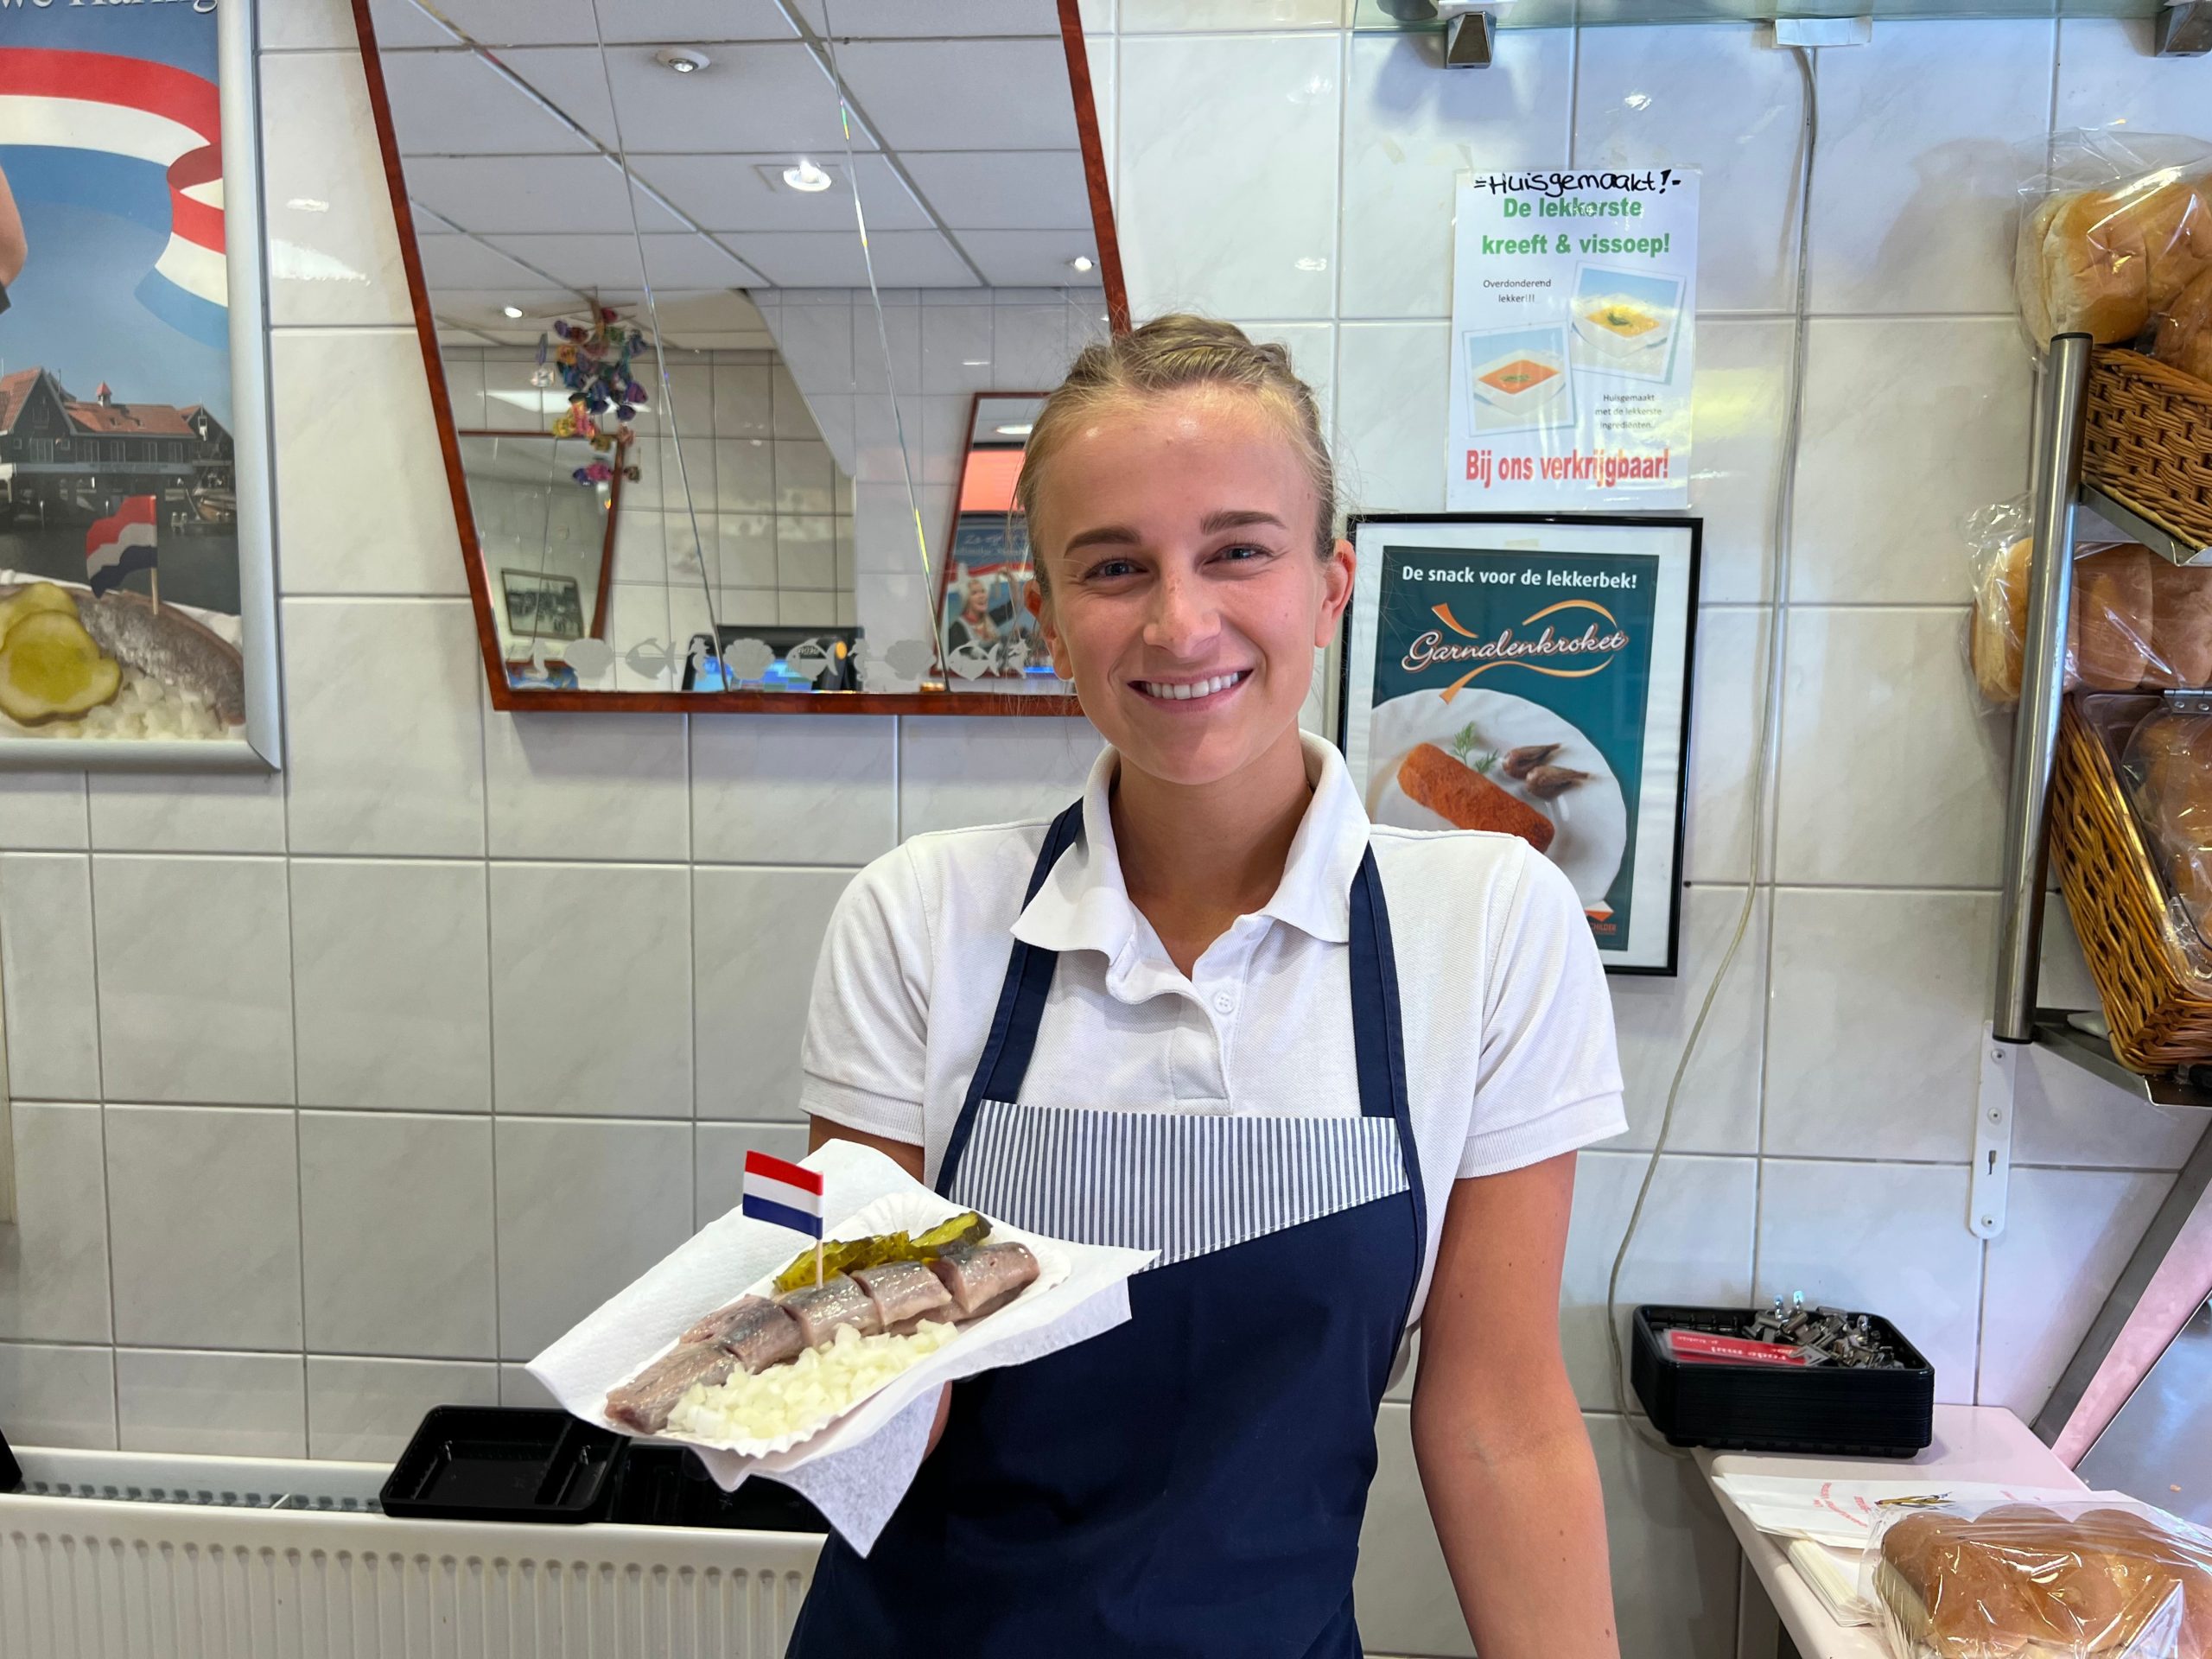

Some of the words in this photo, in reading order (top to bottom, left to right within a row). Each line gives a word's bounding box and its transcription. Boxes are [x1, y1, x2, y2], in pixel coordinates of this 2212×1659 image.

[1503, 198, 1531, 218] De
[1539, 197, 1643, 217] lekkerste
[1482, 234, 1548, 255] kreeft
[1555, 233, 1572, 253] &
[1580, 233, 1670, 257] vissoep!
[1483, 278, 1552, 288] Overdonderend
[1498, 293, 1535, 302] lekker!!!
[1603, 393, 1655, 404] Huisgemaakt
[1612, 407, 1624, 416] de
[1625, 407, 1662, 416] lekkerste
[1465, 449, 1492, 488] Bij
[1498, 455, 1535, 480] ons
[1541, 448, 1670, 487] verkrijgbaar!
[1402, 566, 1423, 582] De
[1428, 566, 1474, 583] snack
[1479, 570, 1516, 585] voor
[1521, 569, 1541, 586] de
[1546, 570, 1637, 589] lekkerbek!
[1401, 622, 1630, 672] Garnalenkroket
